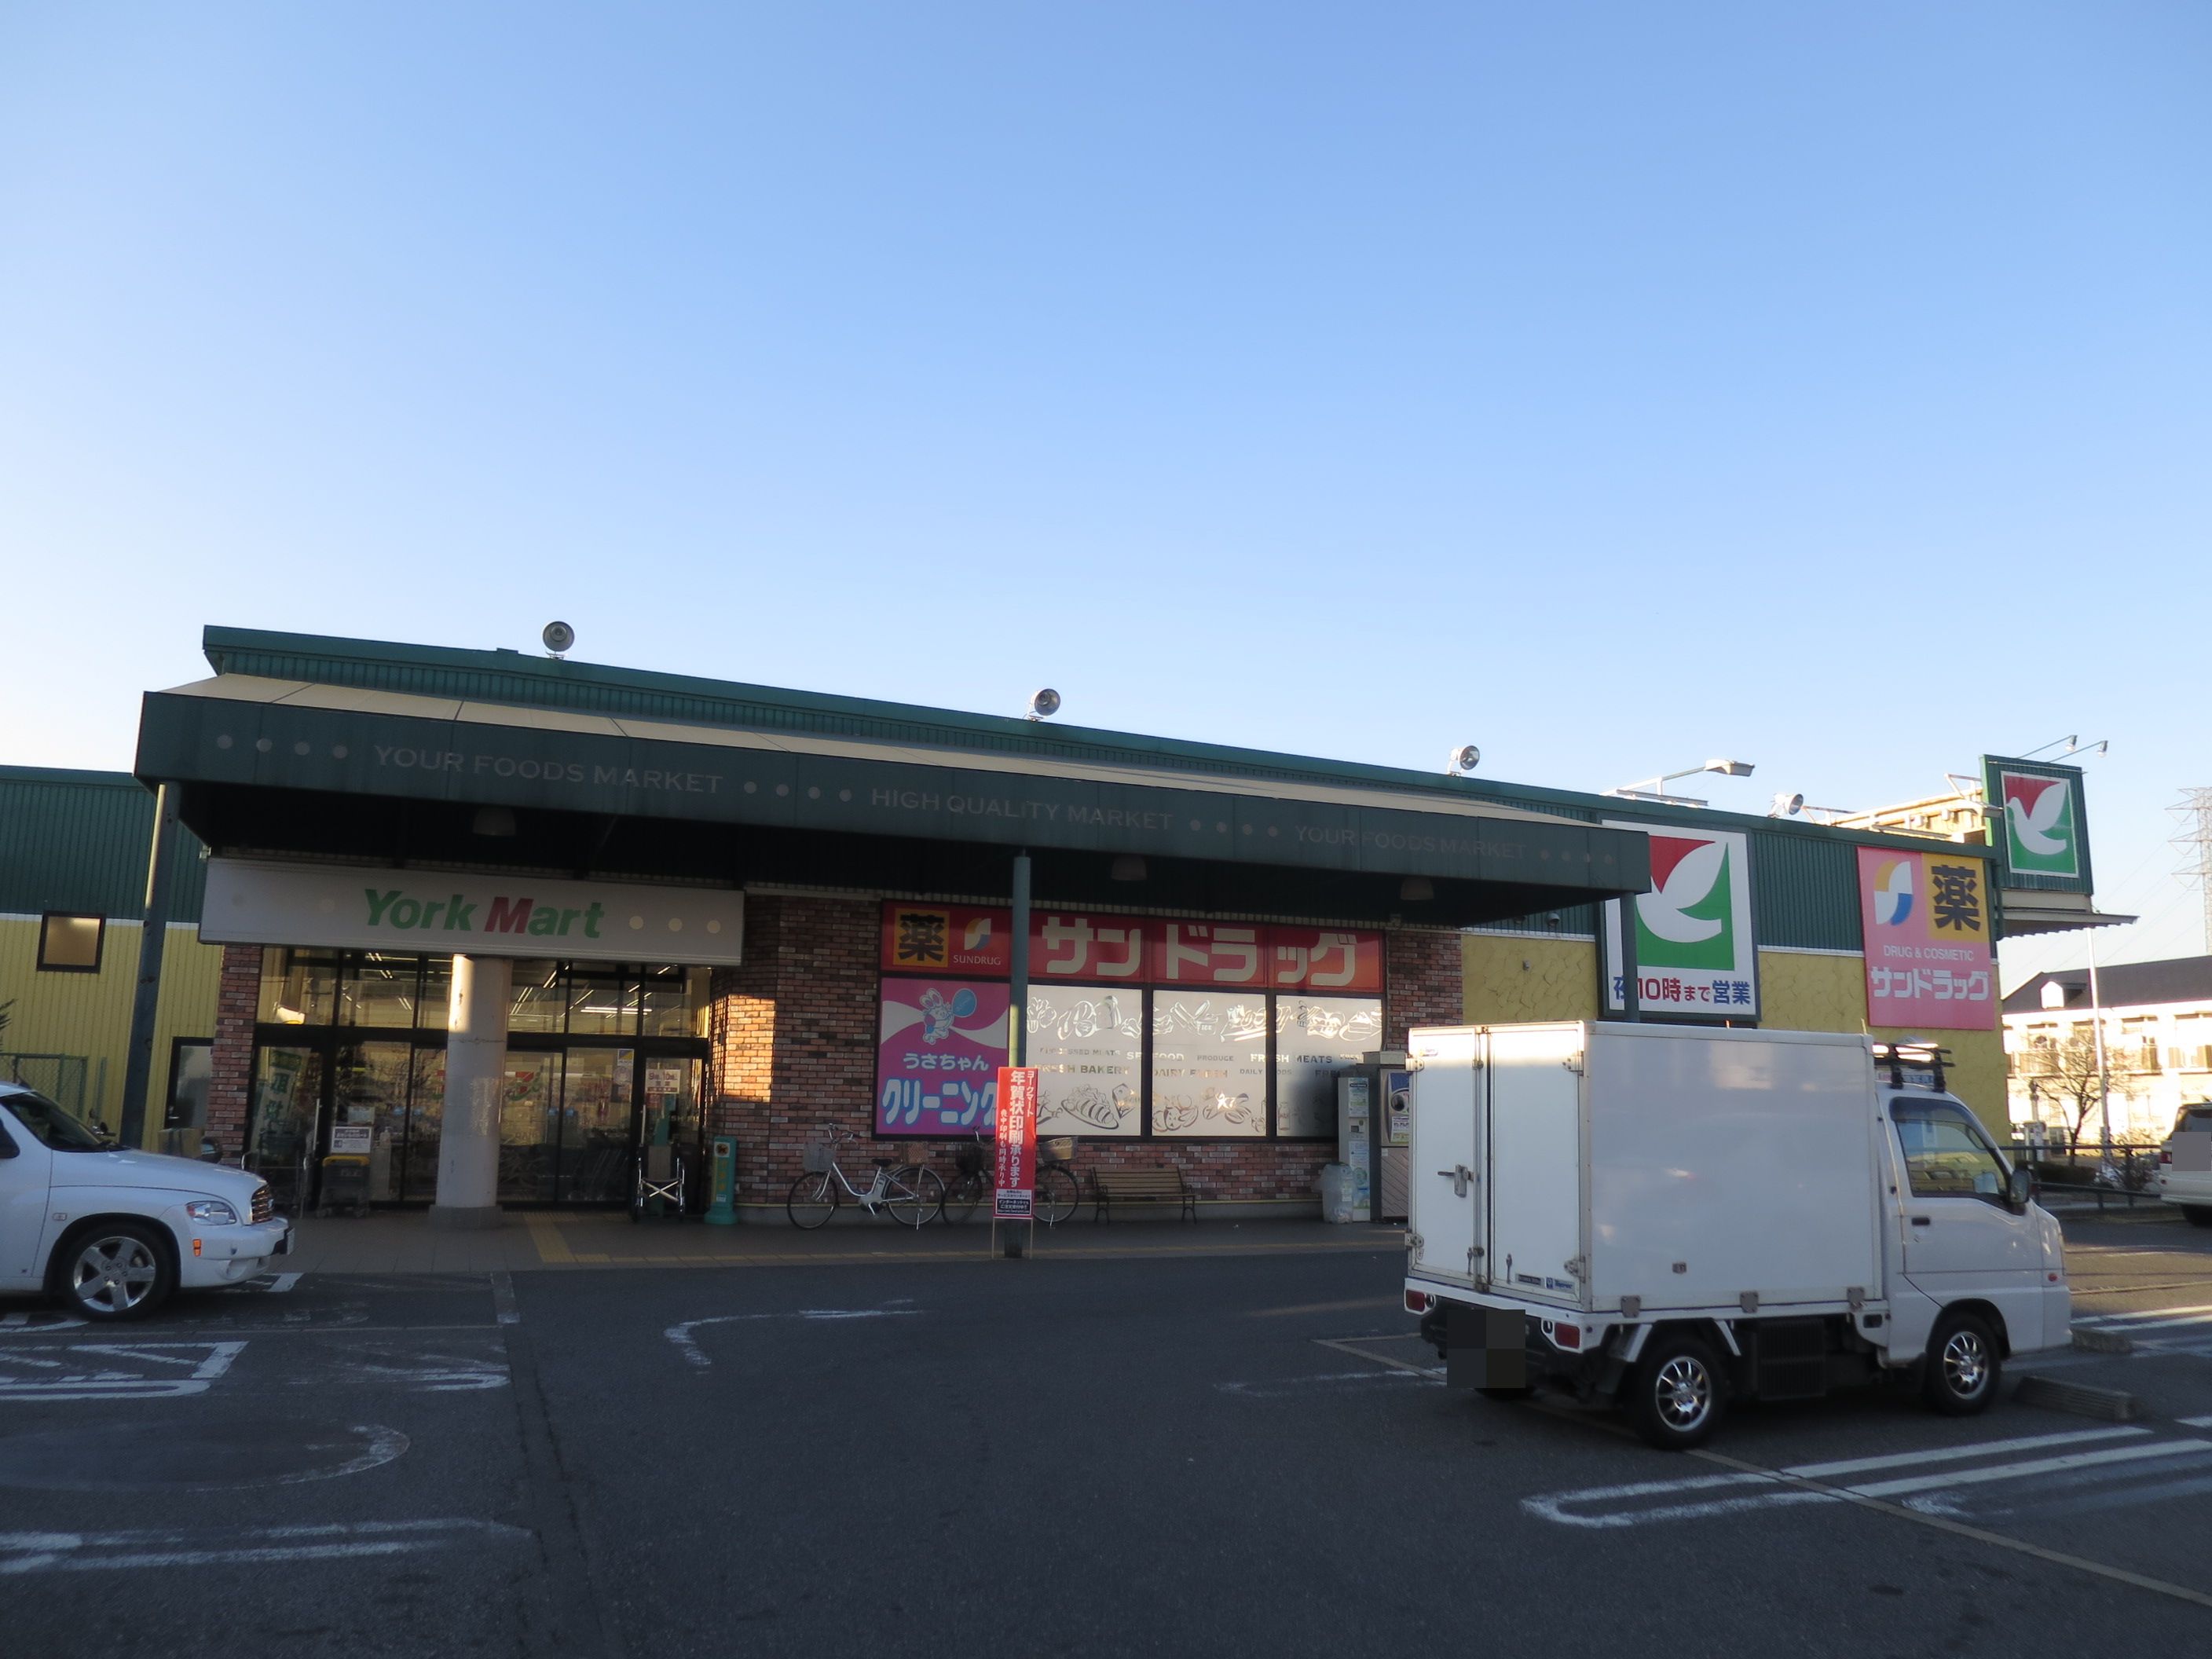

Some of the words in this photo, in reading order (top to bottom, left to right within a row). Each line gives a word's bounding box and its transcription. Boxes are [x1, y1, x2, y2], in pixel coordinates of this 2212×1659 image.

[373, 744, 465, 772] YOUR
[473, 755, 585, 782] FOODS
[593, 765, 724, 794] MARKET
[871, 788, 940, 811] HIGH
[947, 795, 1061, 821] QUALITY
[1068, 805, 1174, 830] MARKET
[1295, 825, 1356, 846] YOUR
[1361, 831, 1436, 852] FOODS
[1441, 838, 1527, 859] MARKET
[364, 888, 478, 932] York
[484, 895, 606, 939] Mart
[1932, 865, 1981, 931] 薬
[898, 914, 945, 962] 薬
[1042, 916, 1357, 987] サンドラッグ
[1884, 945, 1913, 958] DRUG
[1915, 947, 1922, 958] &
[1925, 947, 1974, 961] COSMETIC
[953, 954, 1002, 966] SUNDRUG
[1871, 966, 1989, 1001] サンドラッグ
[903, 1053, 990, 1071] うさちゃん
[1080, 1065, 1130, 1075] BAKERY
[1250, 1053, 1289, 1063] FRSH
[1026, 1071, 1035, 1118] ヨークマート
